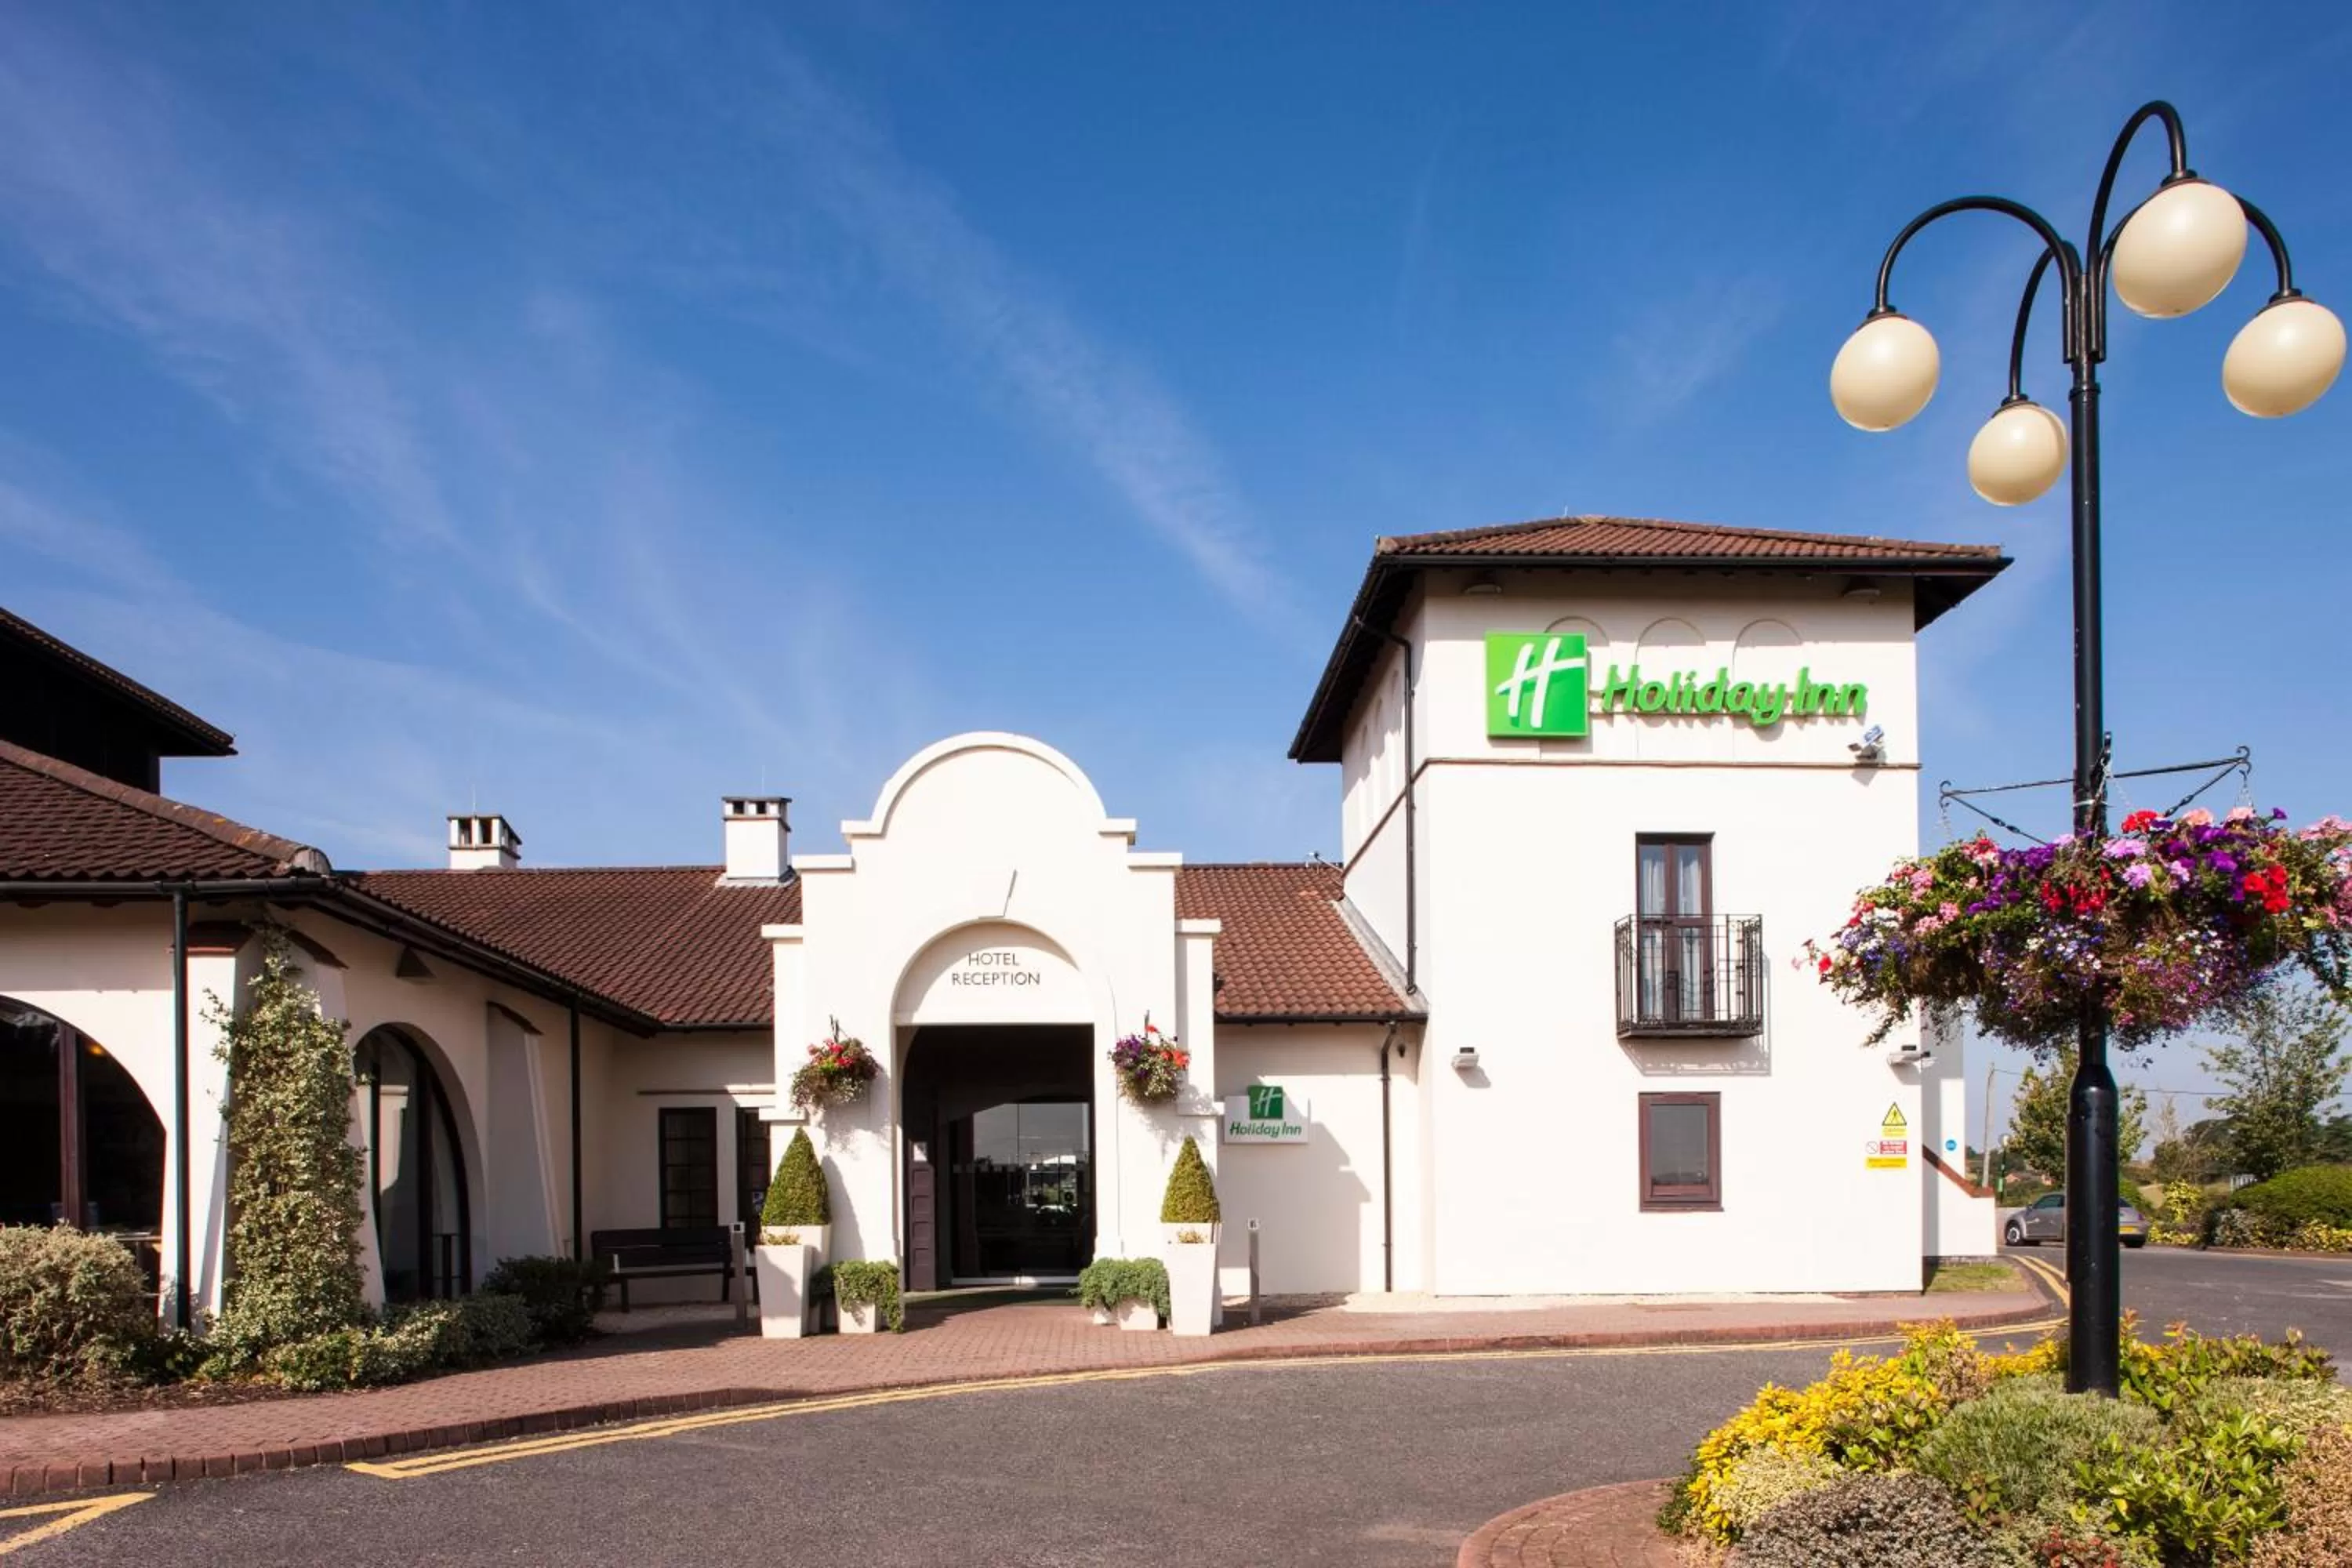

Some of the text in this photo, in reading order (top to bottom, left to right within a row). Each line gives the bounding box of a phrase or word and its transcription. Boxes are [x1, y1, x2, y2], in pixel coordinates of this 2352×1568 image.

[1602, 664, 1868, 725] Holiday Inn
[968, 953, 1019, 966] HOTEL
[952, 971, 1040, 985] RECEPTION
[1229, 1121, 1302, 1138] Holiday Inn
